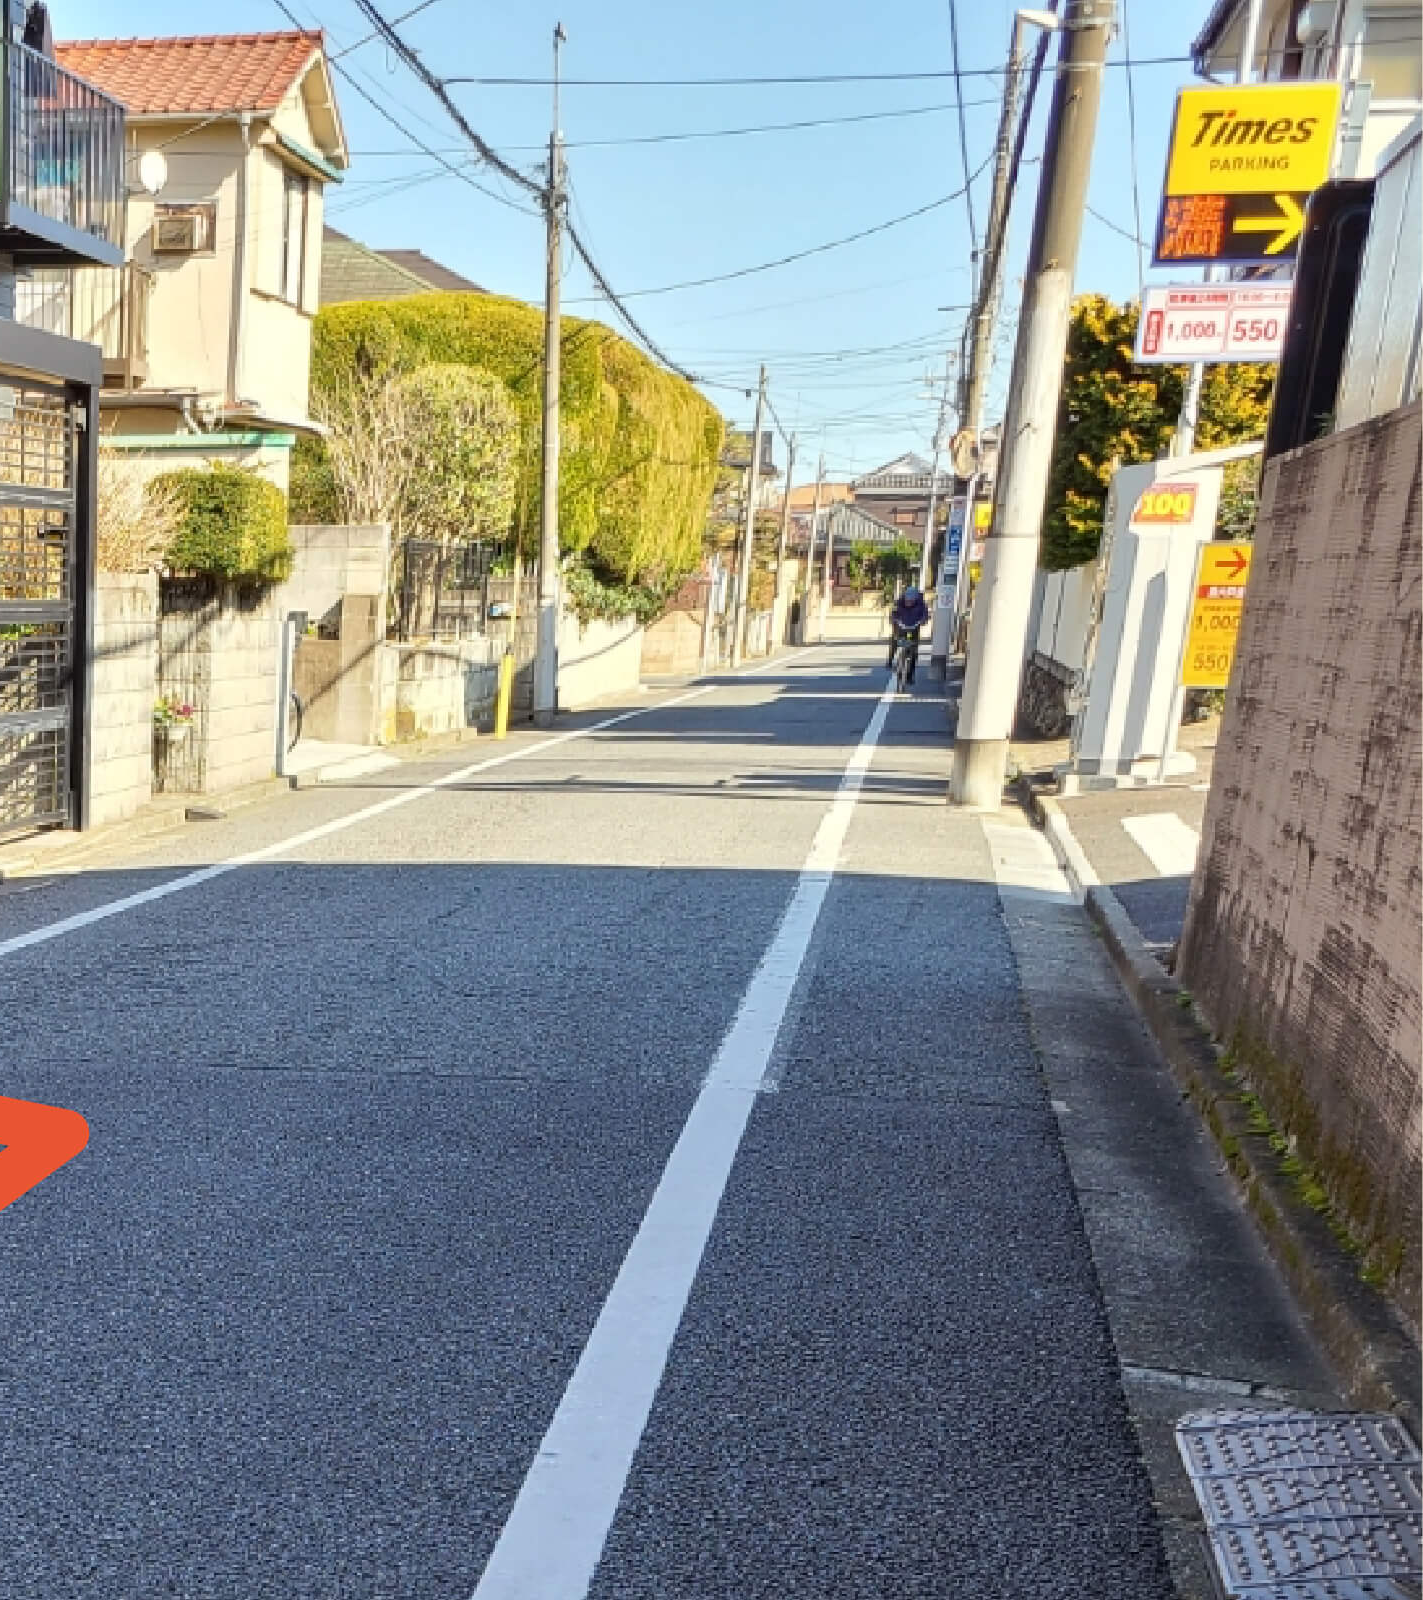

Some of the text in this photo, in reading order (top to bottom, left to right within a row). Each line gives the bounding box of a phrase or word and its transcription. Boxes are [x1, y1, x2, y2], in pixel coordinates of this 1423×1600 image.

[1190, 110, 1319, 147] Times
[1209, 154, 1290, 171] PARKING
[1233, 318, 1278, 342] 550
